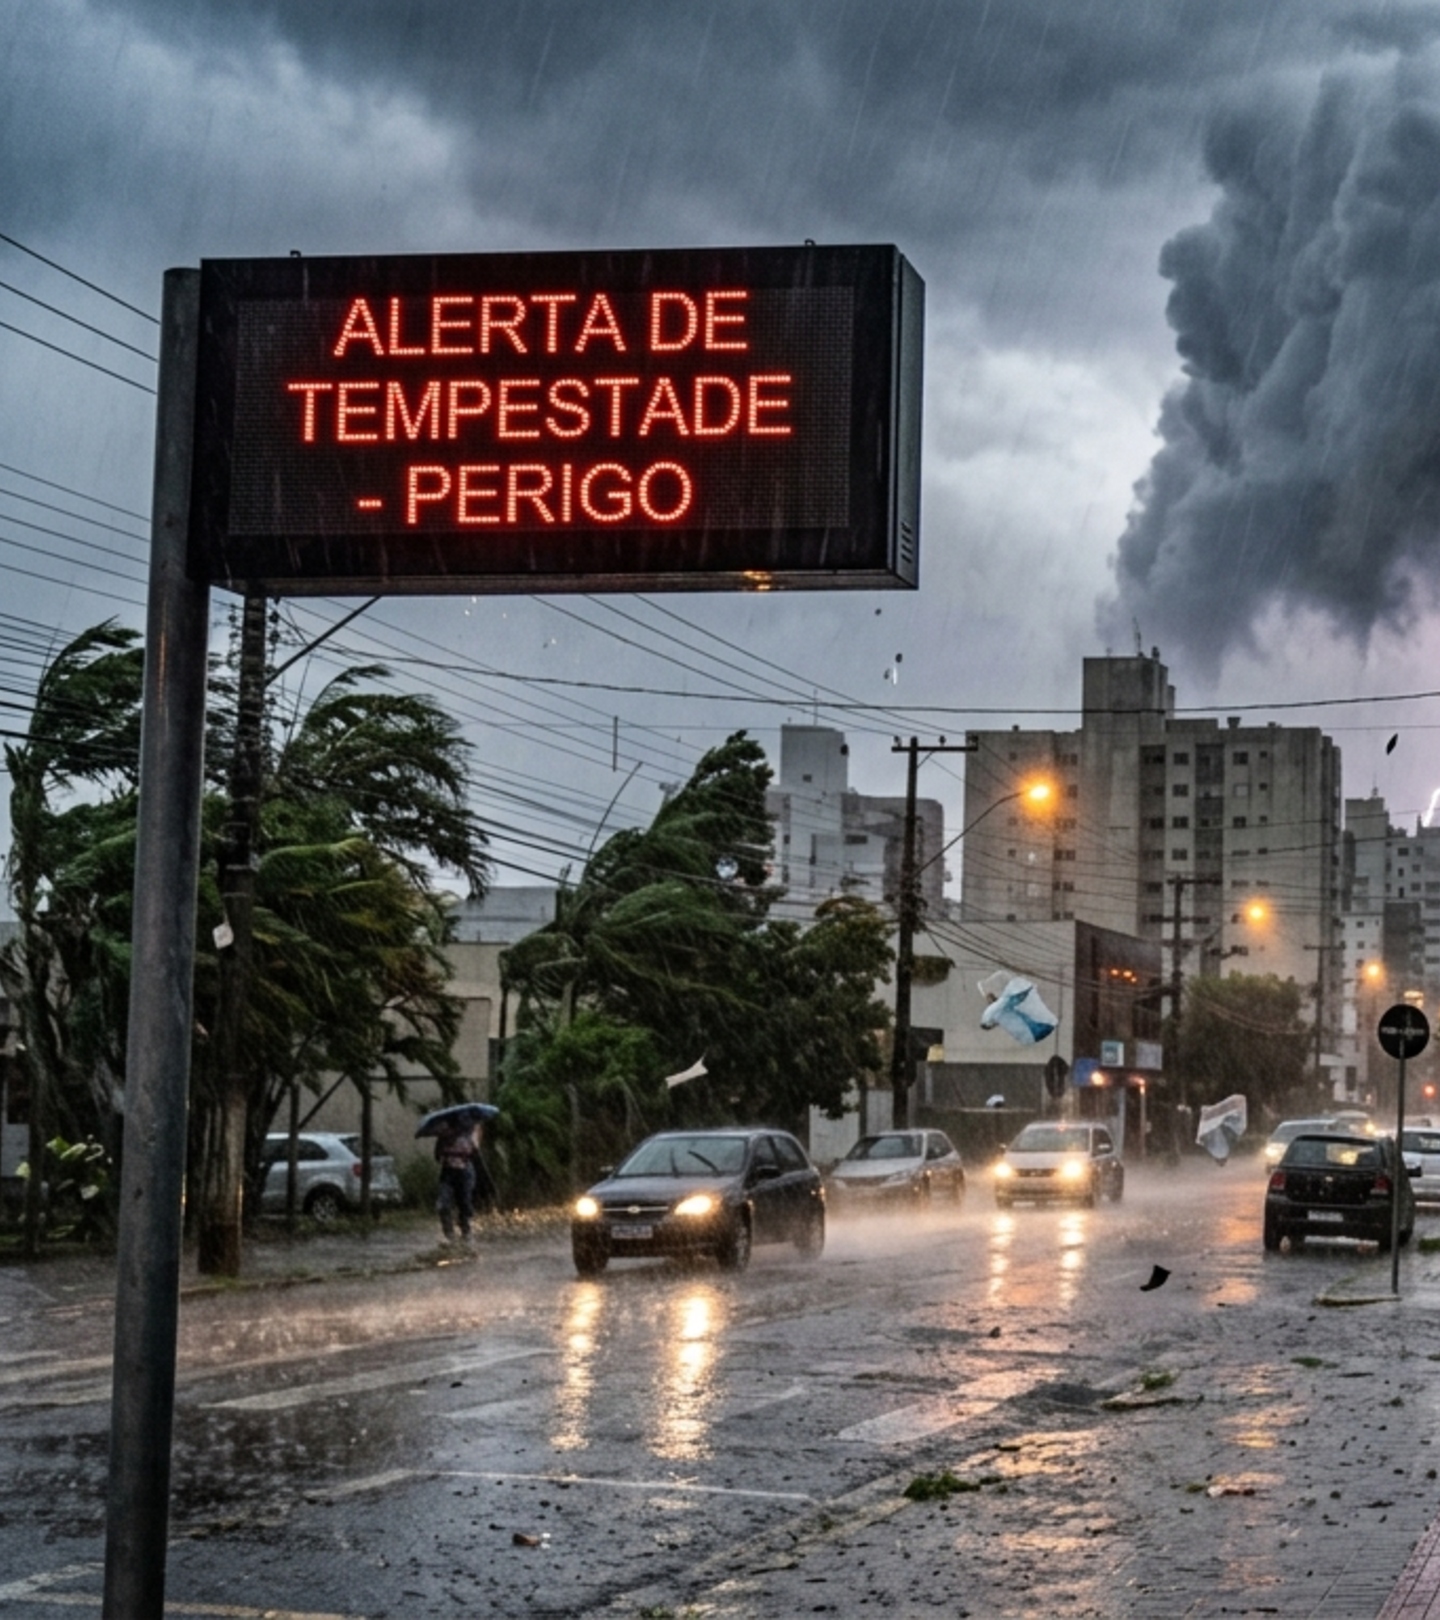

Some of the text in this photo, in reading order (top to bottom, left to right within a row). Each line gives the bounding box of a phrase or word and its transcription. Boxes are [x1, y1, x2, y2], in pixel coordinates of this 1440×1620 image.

[333, 289, 750, 357] ALERTA DE
[286, 374, 793, 443] TEMPESTADE
[358, 460, 693, 526] - PERIGO
